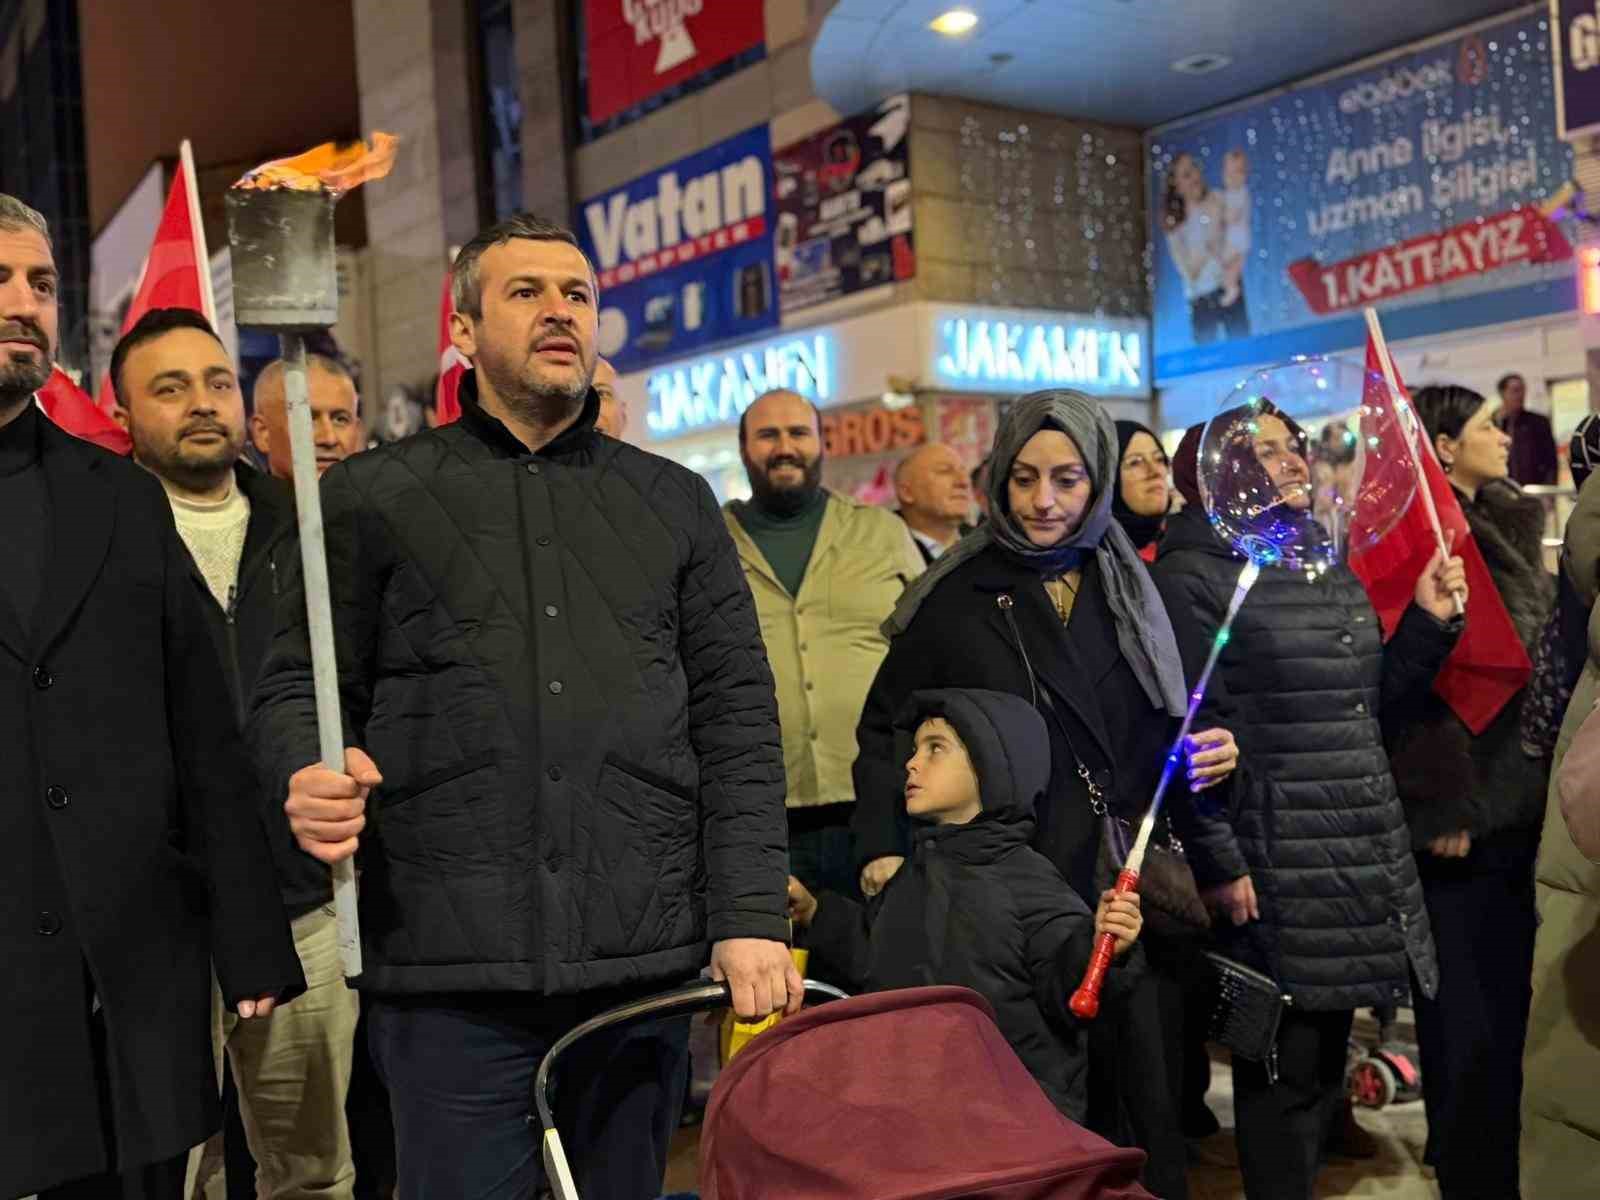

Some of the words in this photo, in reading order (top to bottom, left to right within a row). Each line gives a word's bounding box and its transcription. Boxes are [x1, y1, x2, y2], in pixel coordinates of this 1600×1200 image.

[1326, 137, 1413, 185] Anne
[584, 154, 766, 271] Vatan
[1306, 184, 1424, 236] uzman
[646, 334, 829, 432] JAKAMEN
[937, 319, 1141, 387] JAKAMEN
